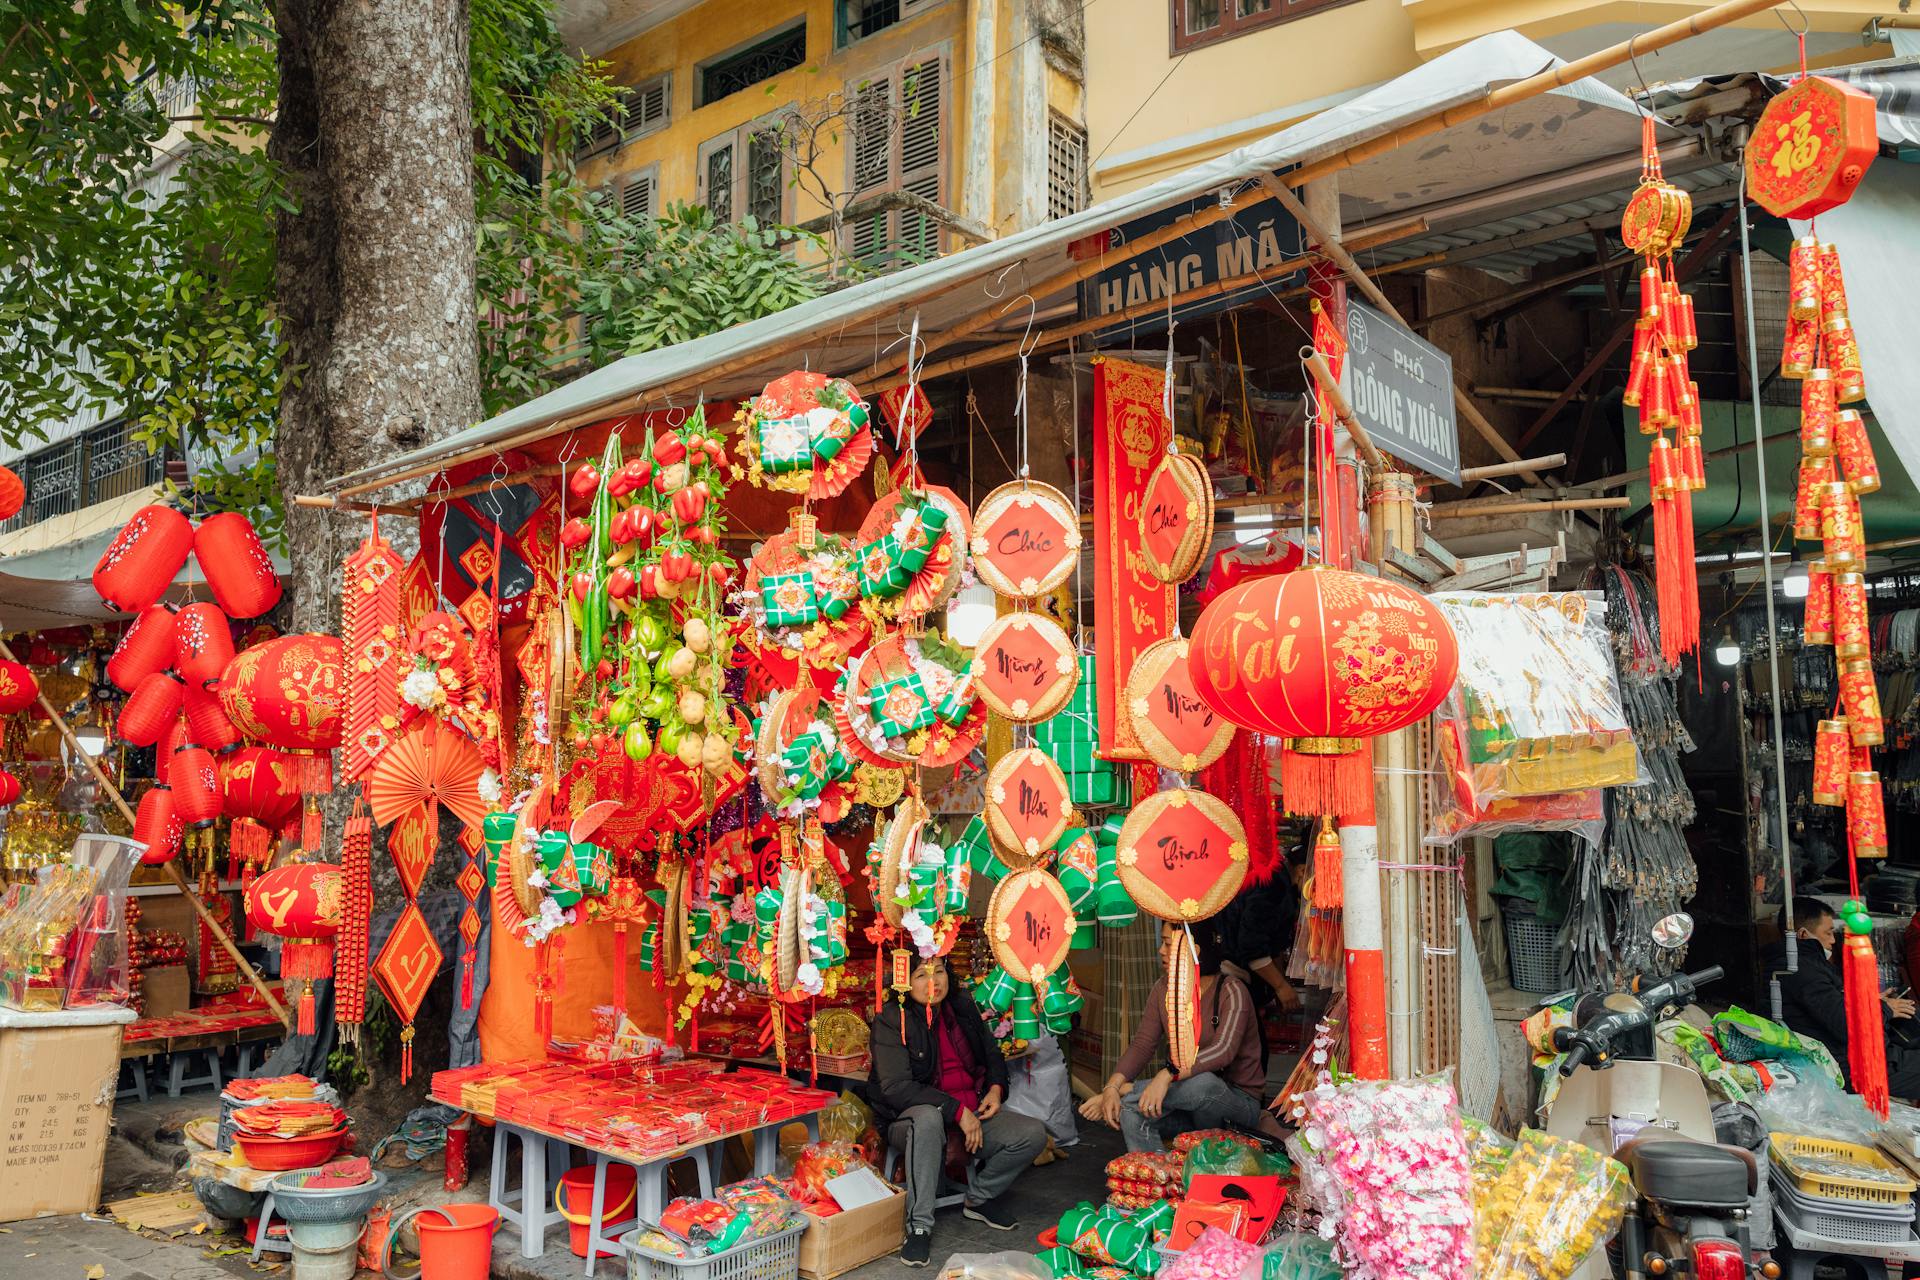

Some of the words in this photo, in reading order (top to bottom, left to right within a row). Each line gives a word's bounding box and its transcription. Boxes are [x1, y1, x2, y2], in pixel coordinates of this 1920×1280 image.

[1771, 111, 1821, 178] 福
[1099, 253, 1203, 315] HÀNG
[1216, 217, 1283, 280] MÃ
[1394, 347, 1425, 384] PHỐ
[1353, 361, 1404, 436] ĐỒNG
[1406, 396, 1452, 461] XUÂN
[1150, 504, 1179, 534] Chúc
[997, 528, 1054, 555] Chúc
[1210, 608, 1301, 691] Tài
[1408, 632, 1438, 651] Năm
[1157, 836, 1209, 870] Thịnh
[17, 1094, 35, 1103] ITEM
[77, 1103, 91, 1112] PCS
[6, 1157, 29, 1167] MADE
[30, 1156, 37, 1164] IN
[38, 1154, 61, 1164] CHINA
